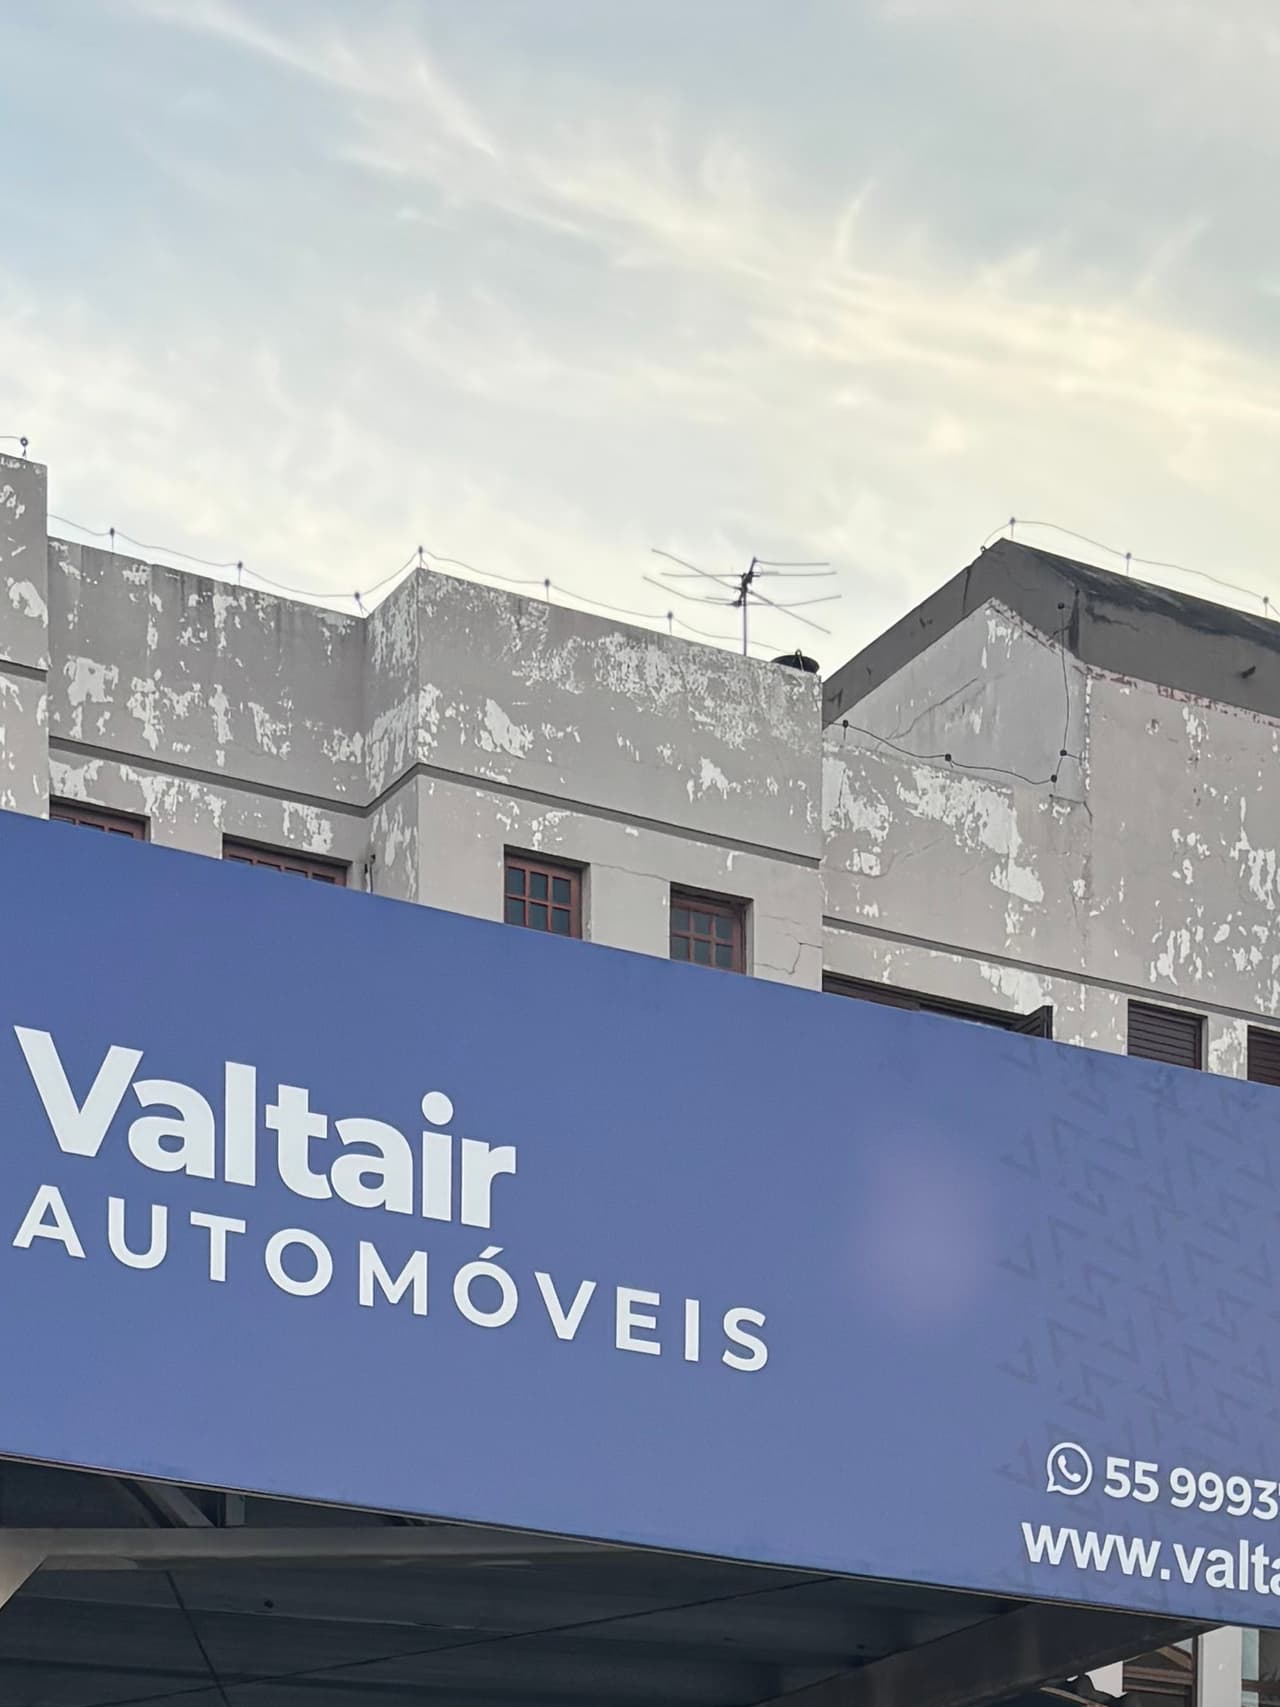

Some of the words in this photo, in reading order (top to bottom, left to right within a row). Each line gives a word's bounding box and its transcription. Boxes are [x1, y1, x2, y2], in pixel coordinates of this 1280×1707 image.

[13, 1025, 518, 1229] Valtair
[12, 1184, 769, 1373] AUTOMÓVEIS
[1103, 1455, 1160, 1503] 55
